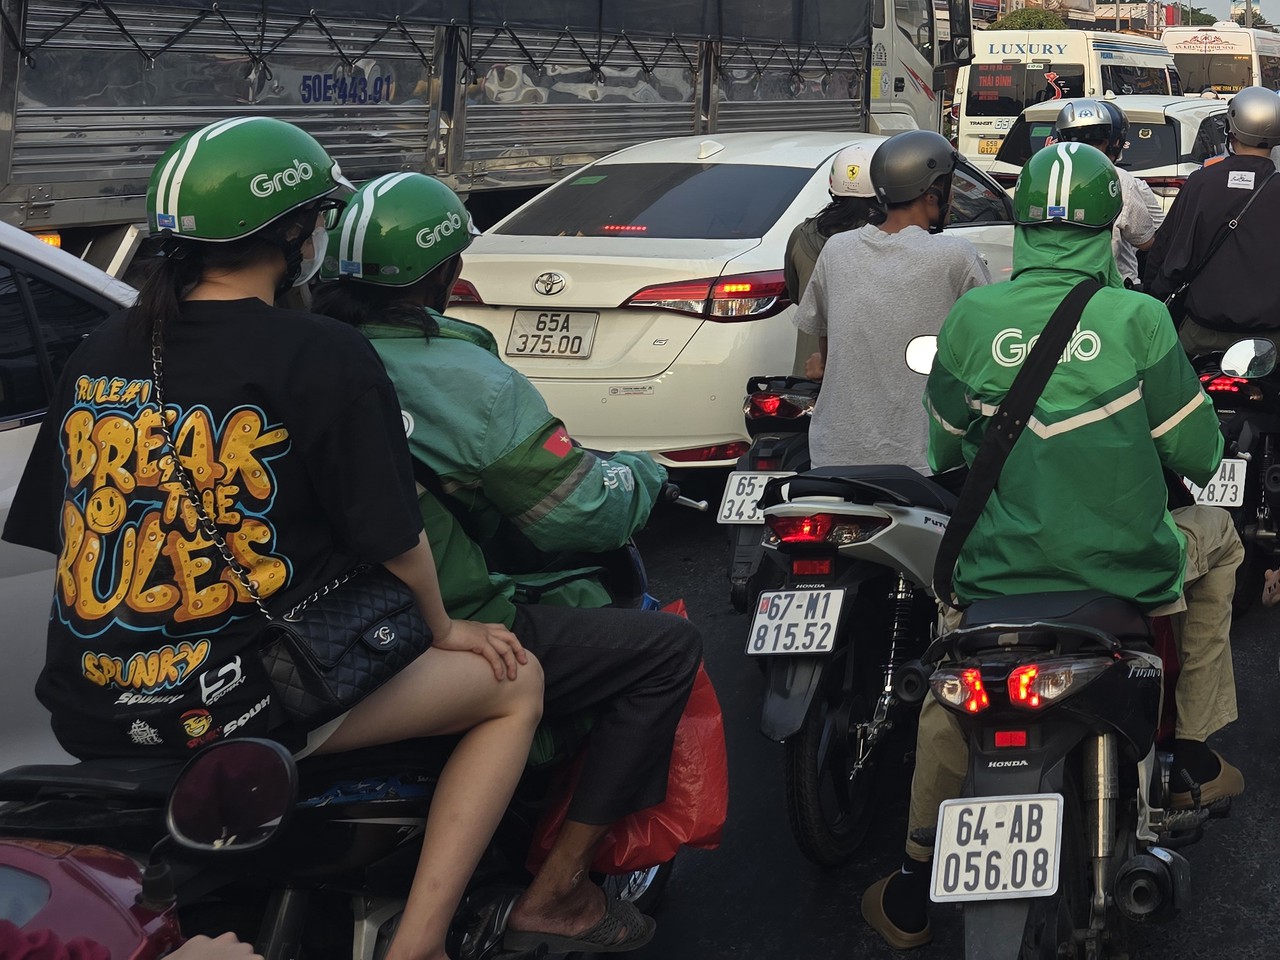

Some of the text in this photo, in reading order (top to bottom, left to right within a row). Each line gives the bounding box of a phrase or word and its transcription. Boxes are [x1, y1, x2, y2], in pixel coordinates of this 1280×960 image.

[989, 44, 1067, 54] LUXURY
[979, 74, 993, 86] THÁI
[250, 160, 313, 197] Grab
[415, 212, 461, 248] Grab
[536, 313, 570, 332] 65A
[516, 334, 582, 354] 375.00
[65, 409, 289, 499] BREAK
[736, 476, 772, 496] 65-
[1190, 483, 1238, 502] 28.73
[159, 482, 240, 532] THE
[723, 499, 764, 520] 343.
[57, 501, 287, 622] RULES
[767, 592, 831, 621] 67-M1
[753, 623, 831, 651] 815.52
[84, 640, 209, 688] SPUNKY
[988, 759, 1028, 768] HONDA
[956, 803, 1044, 847] 64-AB
[943, 848, 1049, 893] 056.08
